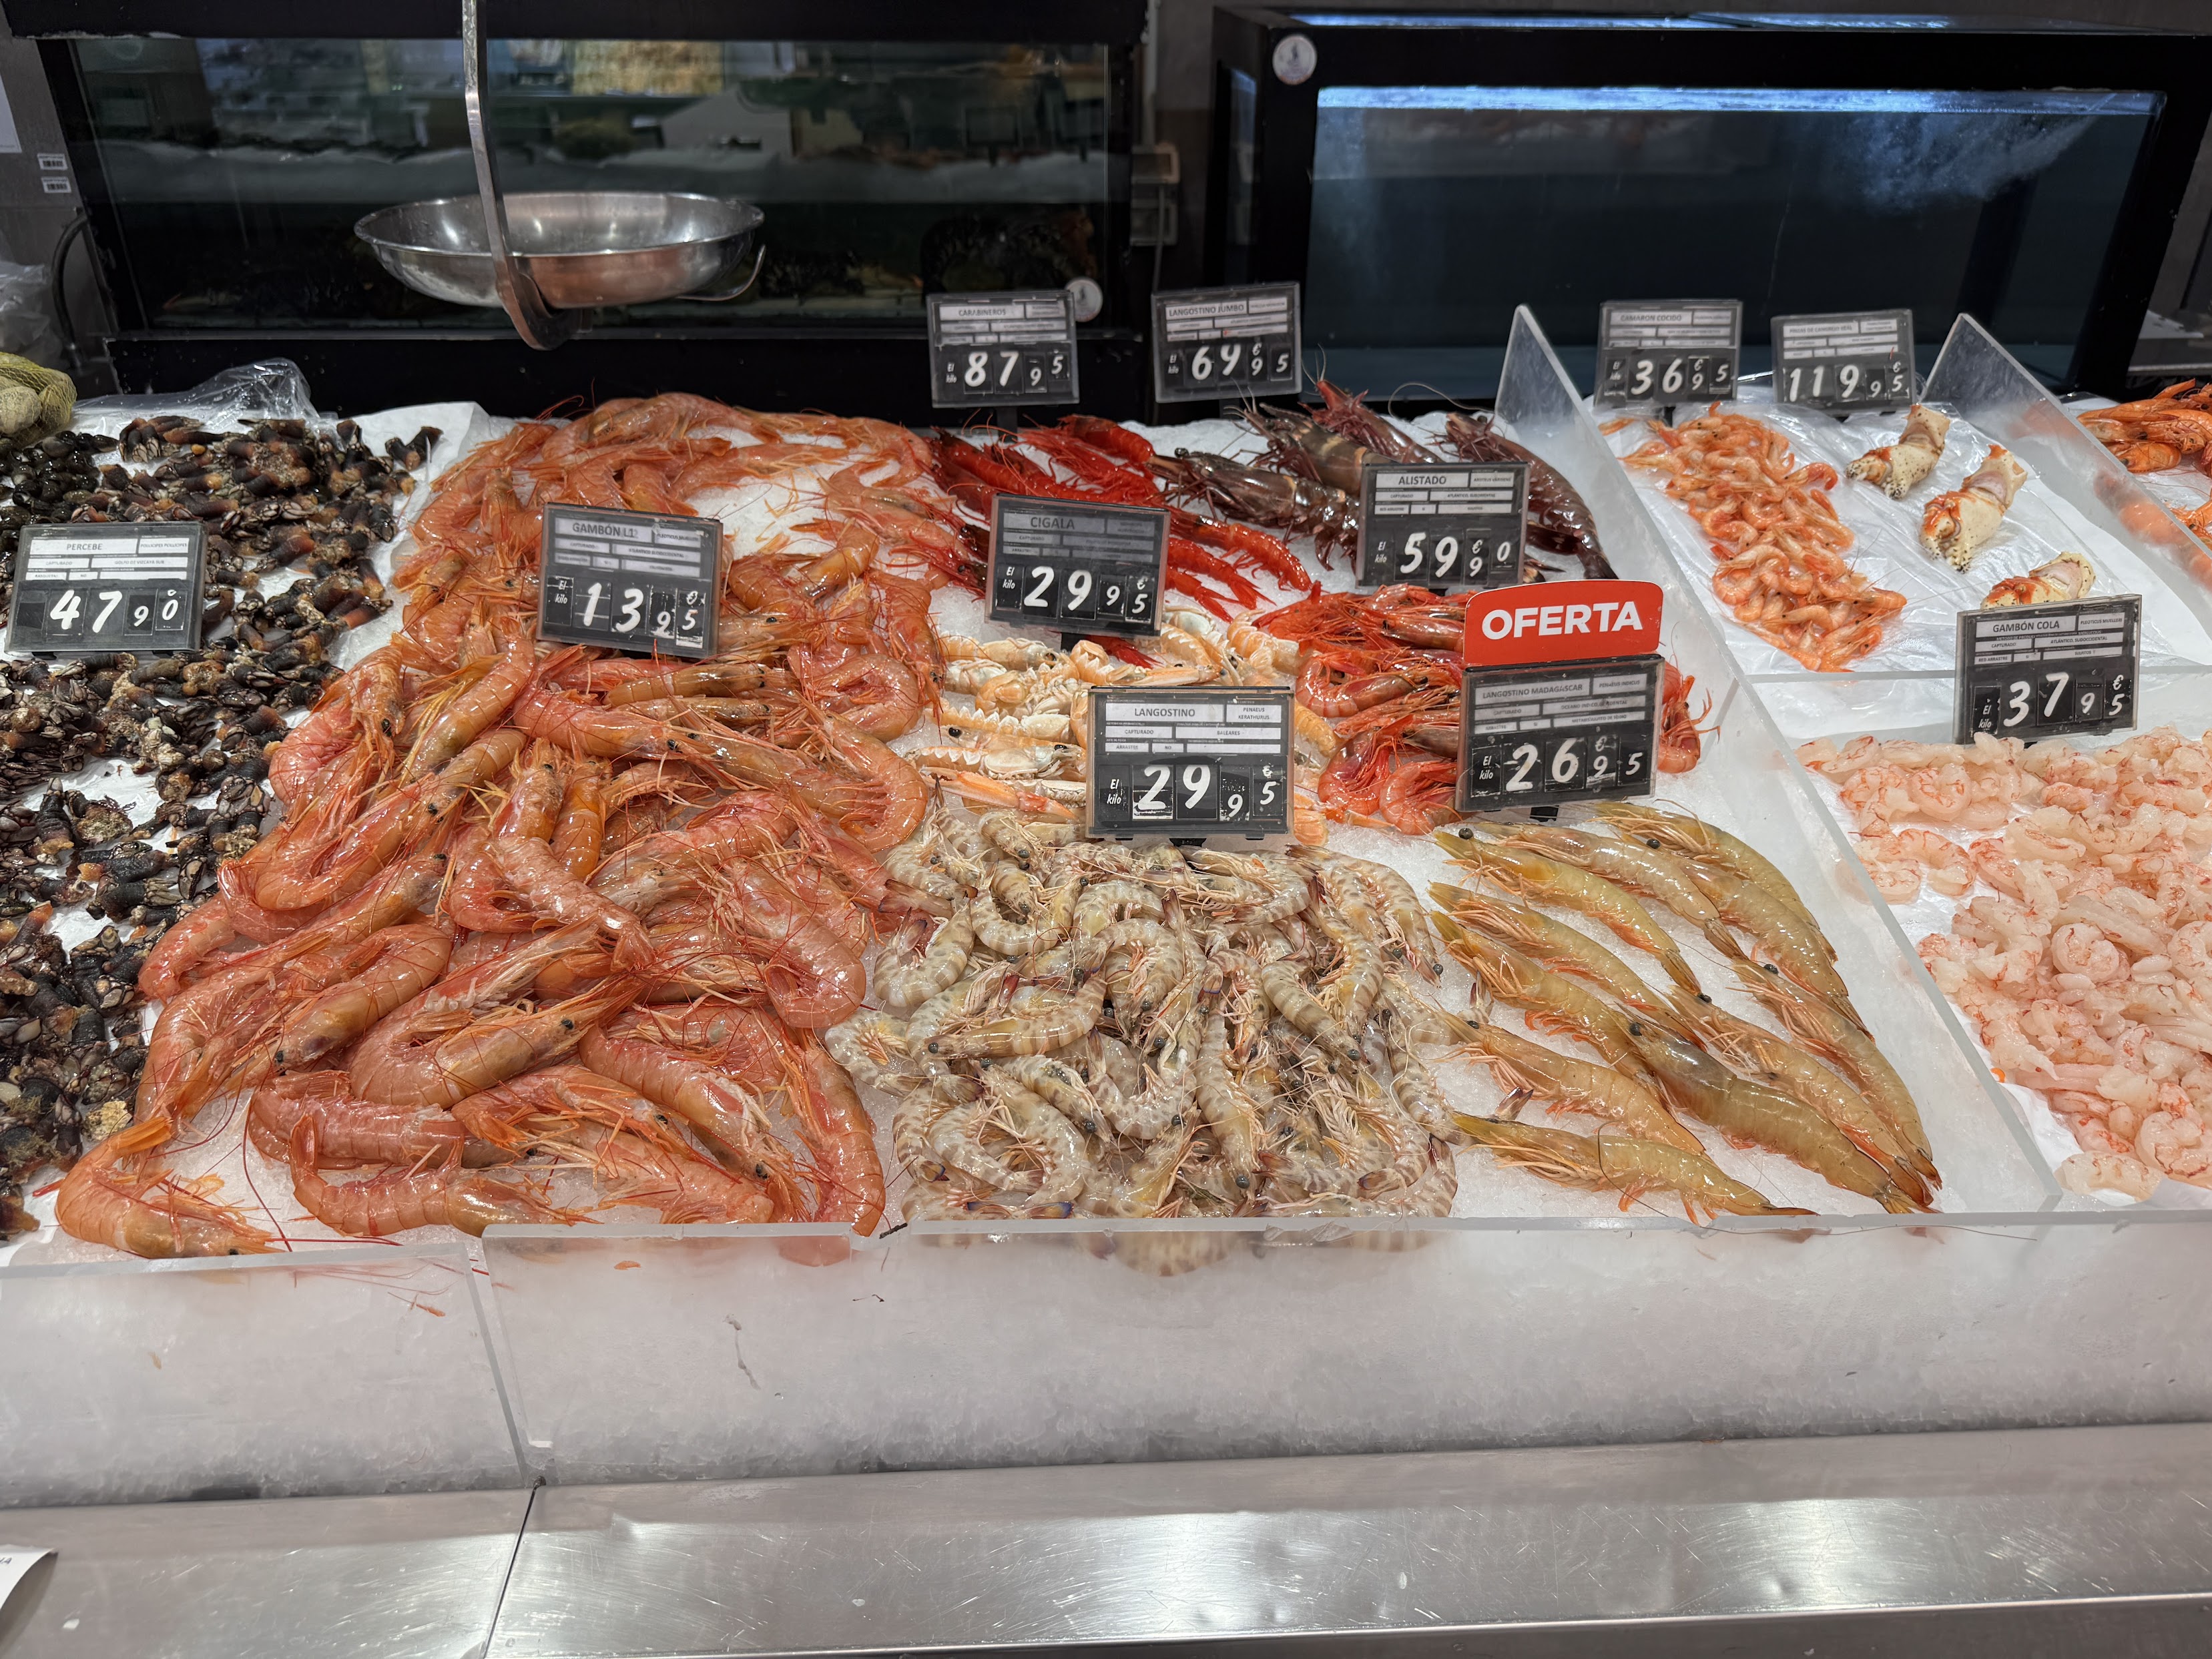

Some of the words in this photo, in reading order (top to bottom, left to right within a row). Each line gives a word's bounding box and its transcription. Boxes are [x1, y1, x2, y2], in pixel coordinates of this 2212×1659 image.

[958, 308, 1007, 317] CARABINEROS
[1169, 306, 1216, 317] LANGOSTINO
[1217, 304, 1245, 314] JUMBO
[1657, 314, 1682, 322] COCIDO
[964, 352, 1019, 387] 87
[1631, 358, 1683, 396] 36
[1789, 364, 1860, 402] 119
[1398, 475, 1448, 486] ALISTADO
[1031, 516, 1075, 530] CIGALA
[572, 522, 621, 537] GAMBÓN
[66, 543, 103, 551] PERCEBE
[1378, 541, 1386, 551] El
[1375, 553, 1388, 564] kilo
[1400, 531, 1458, 579] 59
[1471, 539, 1483, 555] €
[1006, 566, 1015, 577] El
[559, 580, 567, 590] El
[1002, 579, 1016, 590] kilo
[1023, 565, 1093, 611] 29
[555, 593, 568, 605] kilo
[49, 589, 123, 634] 47
[583, 582, 644, 633] 13
[1481, 601, 1643, 641] OFERTA
[1992, 621, 2034, 633] GAMBÓN
[2037, 620, 2060, 630] COLA
[1482, 688, 1530, 699] LANGOSTINO
[2003, 671, 2070, 727] 37
[1134, 707, 1195, 717] LANGOSTINO
[1982, 704, 1990, 715] El
[1978, 717, 1992, 729] kilo
[1482, 755, 1491, 767] El
[1505, 737, 1579, 792] 26
[1479, 769, 1494, 780] kilo
[1111, 779, 1119, 790] El
[1137, 765, 1211, 809] 29
[1107, 793, 1121, 805] kilo
